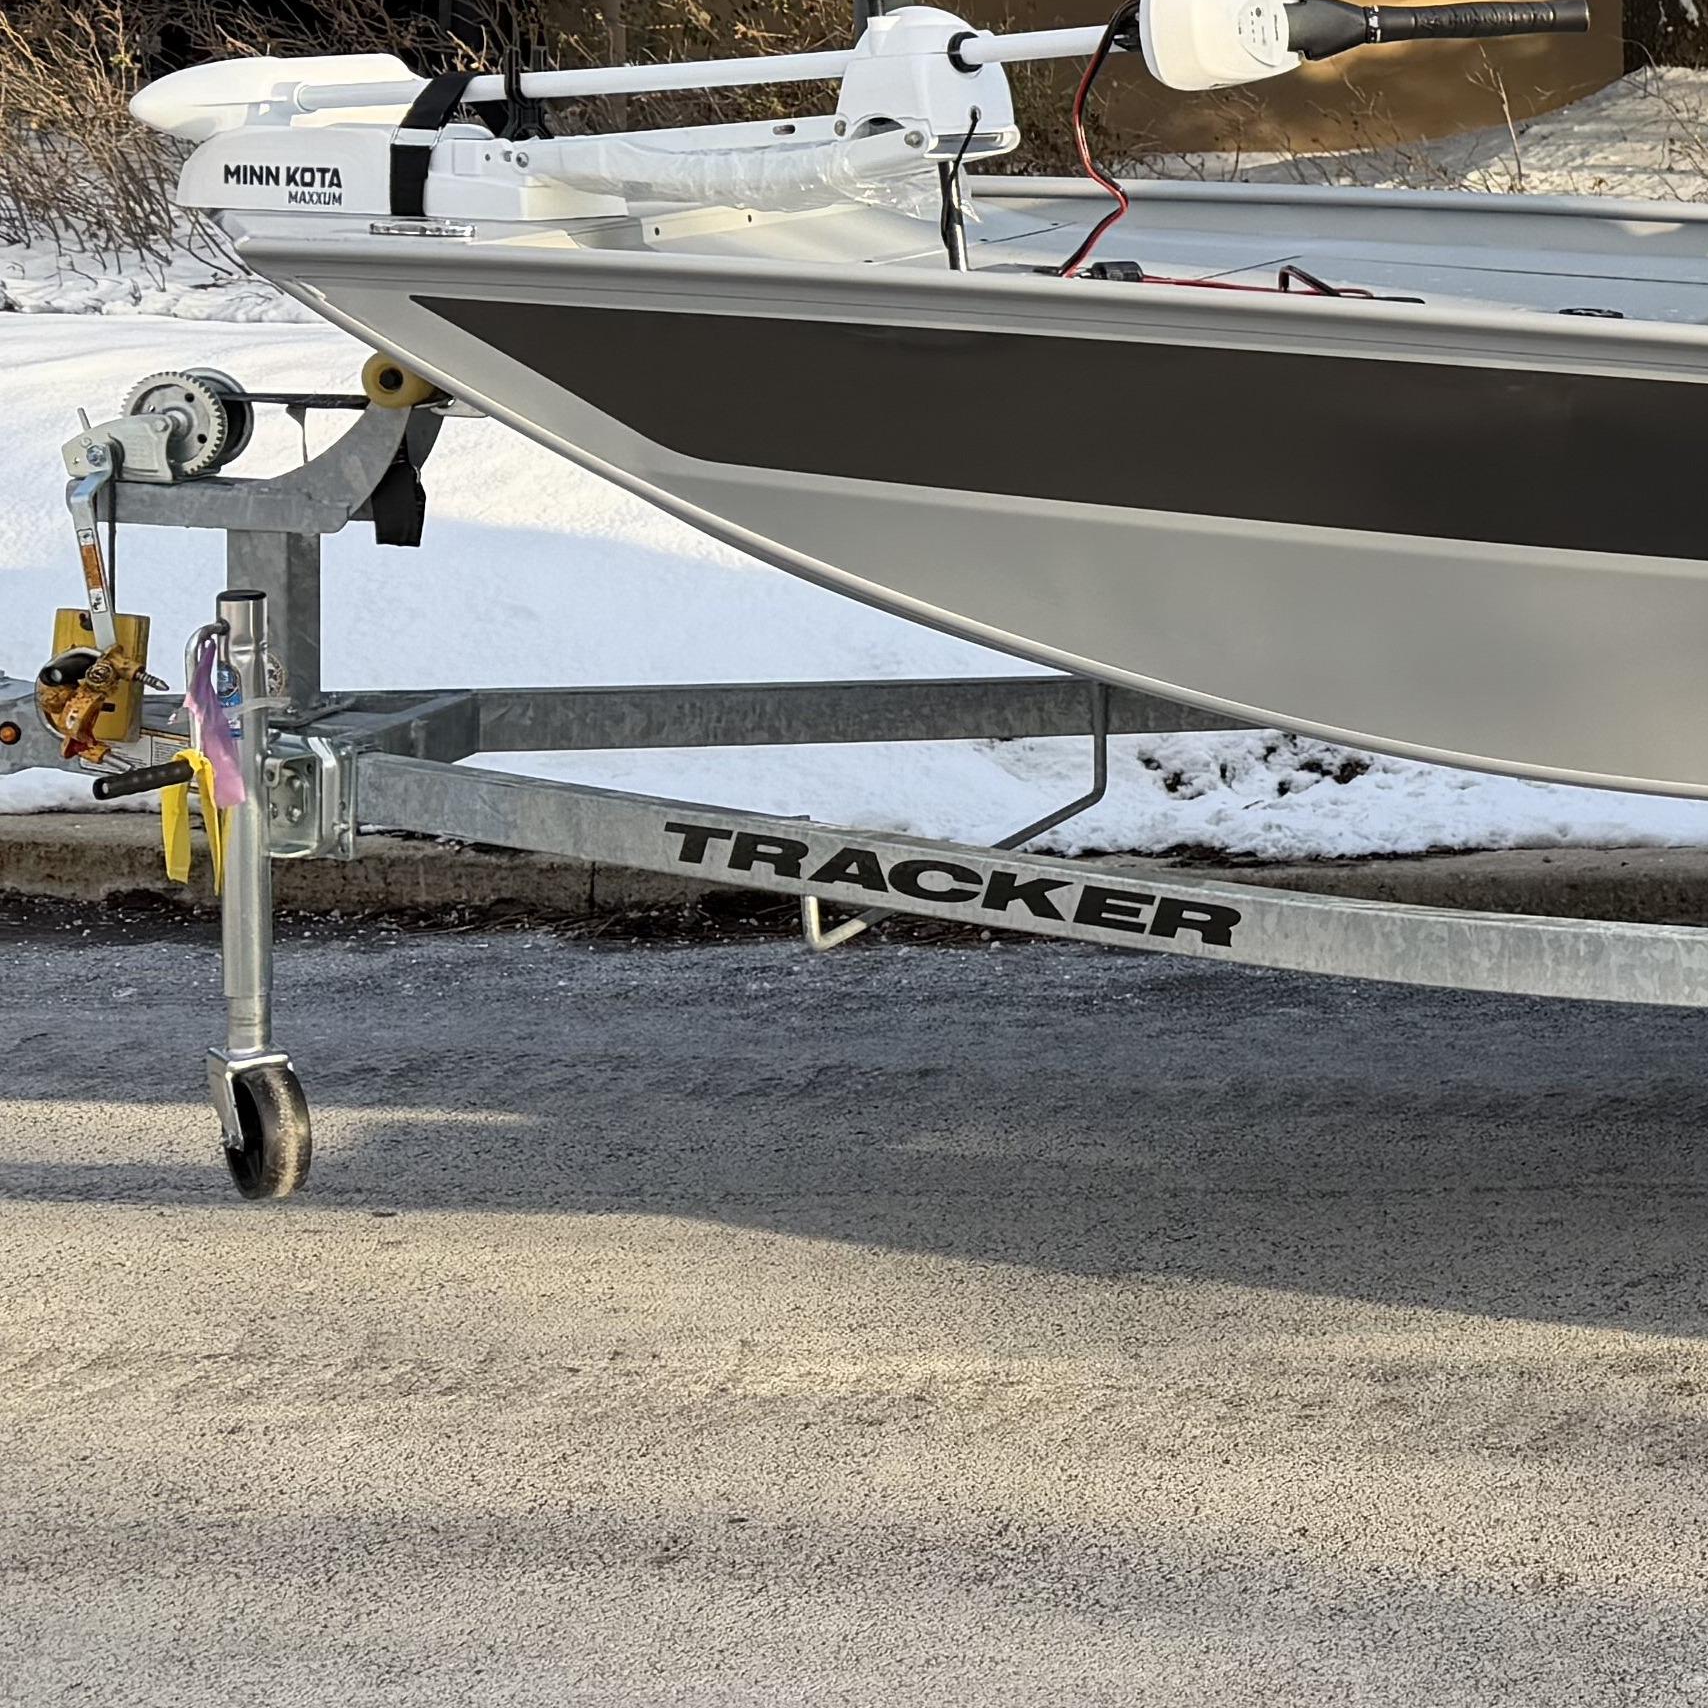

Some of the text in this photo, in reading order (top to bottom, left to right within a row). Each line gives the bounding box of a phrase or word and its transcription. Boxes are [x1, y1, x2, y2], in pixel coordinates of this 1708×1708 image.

[224, 164, 342, 188] MINN KOTA
[288, 190, 342, 205] MAXXUM
[664, 822, 1242, 947] TRACKER
